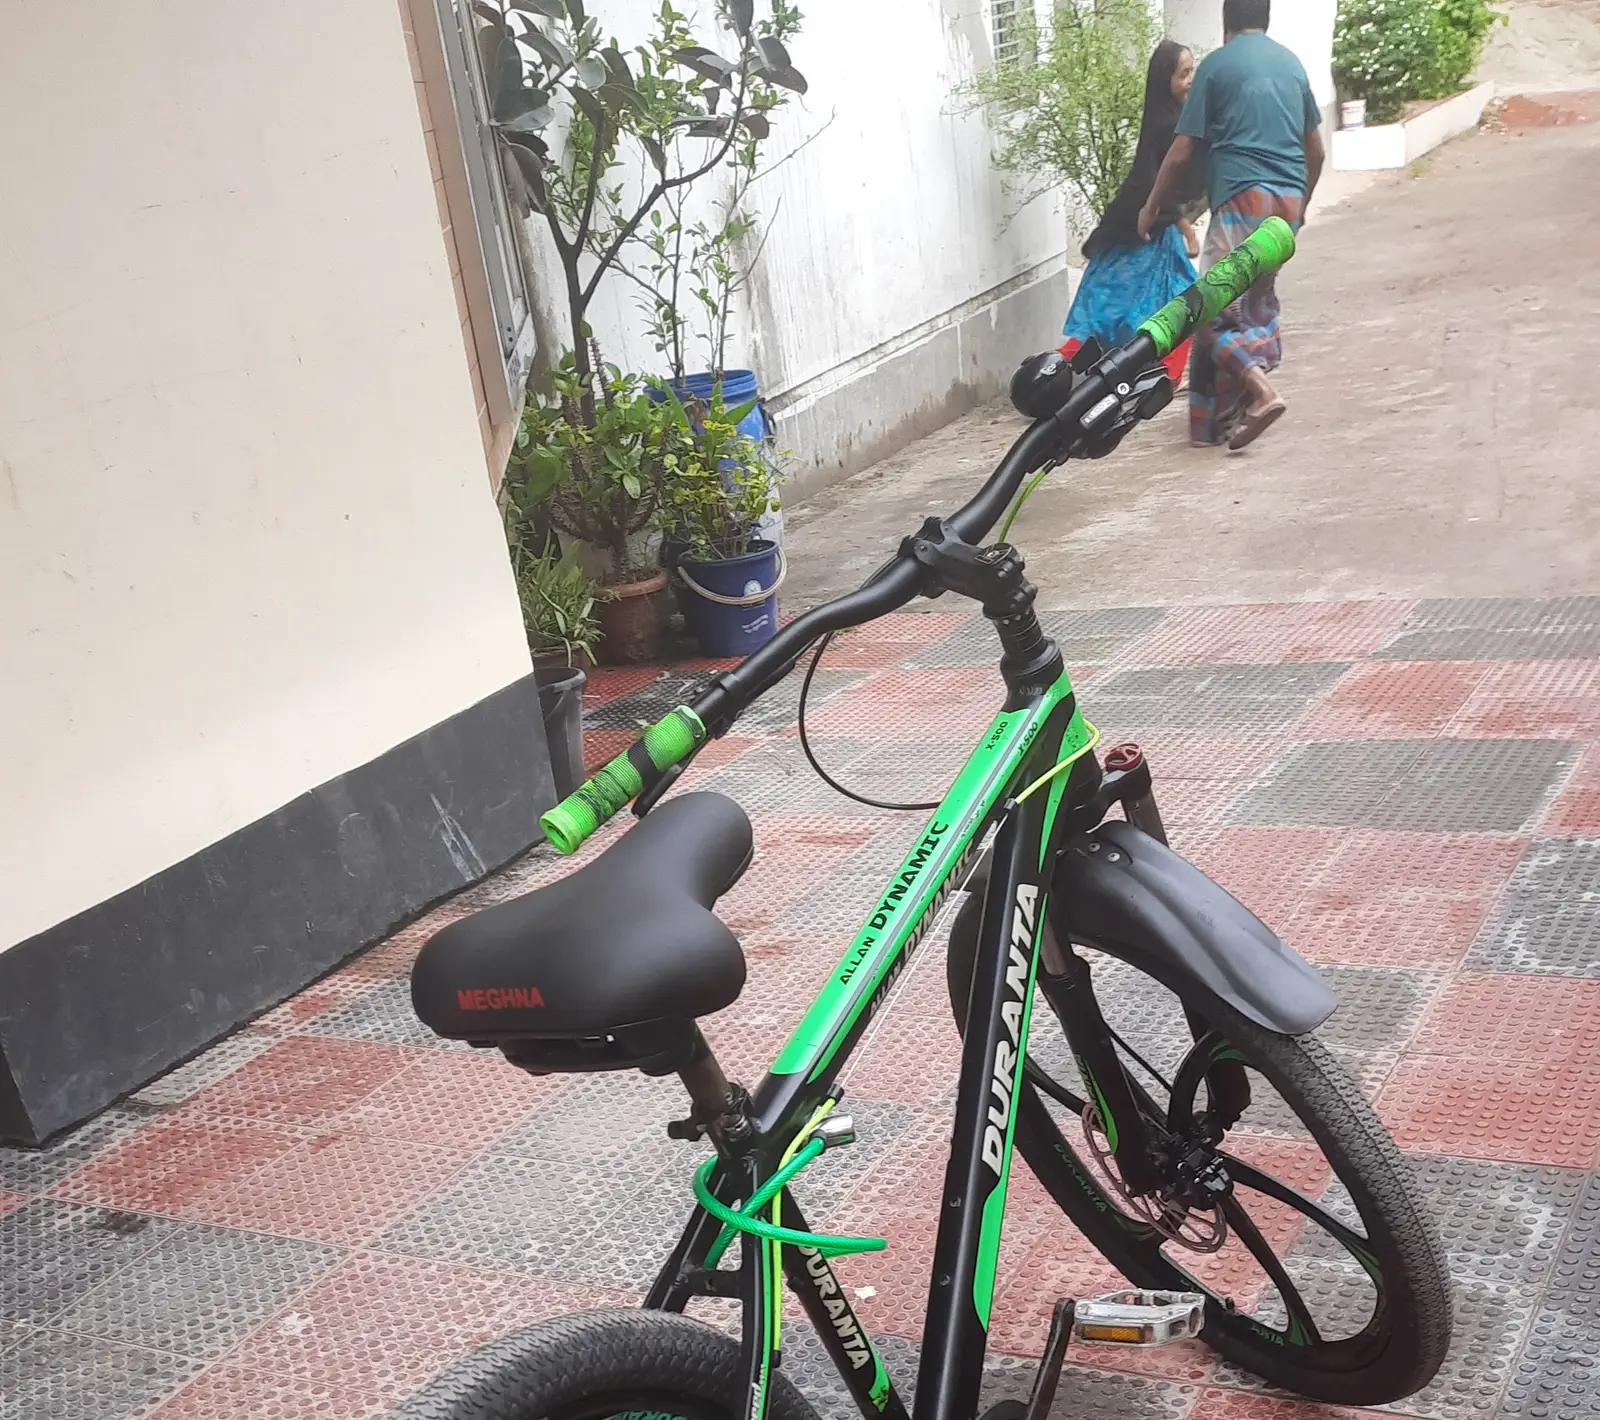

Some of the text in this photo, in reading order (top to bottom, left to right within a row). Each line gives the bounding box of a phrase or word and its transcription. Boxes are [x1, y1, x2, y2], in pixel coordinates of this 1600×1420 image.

[839, 821, 949, 985] ALLAN DYNAMIC
[903, 838, 975, 962] DYNAMIC
[456, 987, 545, 1011] MEGHNA
[982, 883, 1039, 1178] DURANTA
